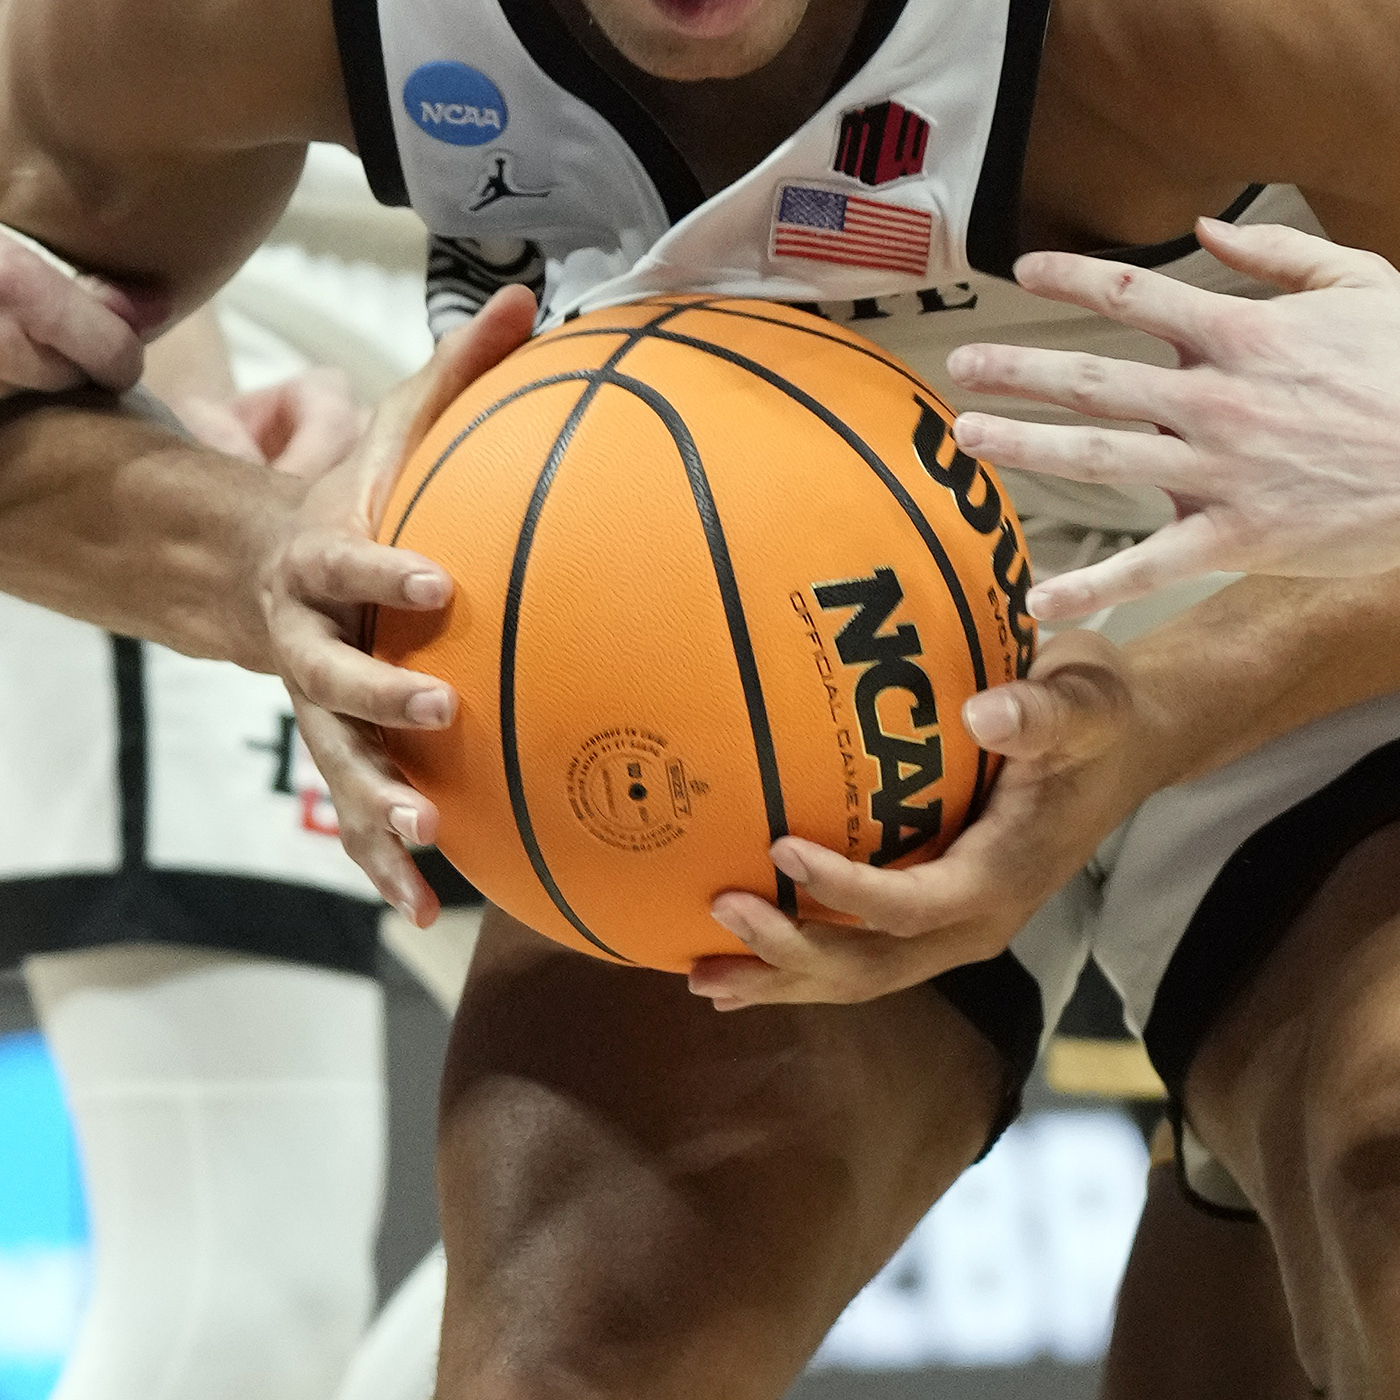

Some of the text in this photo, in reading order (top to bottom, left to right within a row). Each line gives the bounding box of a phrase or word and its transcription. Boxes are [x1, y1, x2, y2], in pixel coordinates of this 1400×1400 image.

[420, 100, 501, 130] NCAA
[789, 590, 838, 724] OFFICIAL
[836, 727, 860, 812] GAME
[810, 565, 945, 868] NCAA
